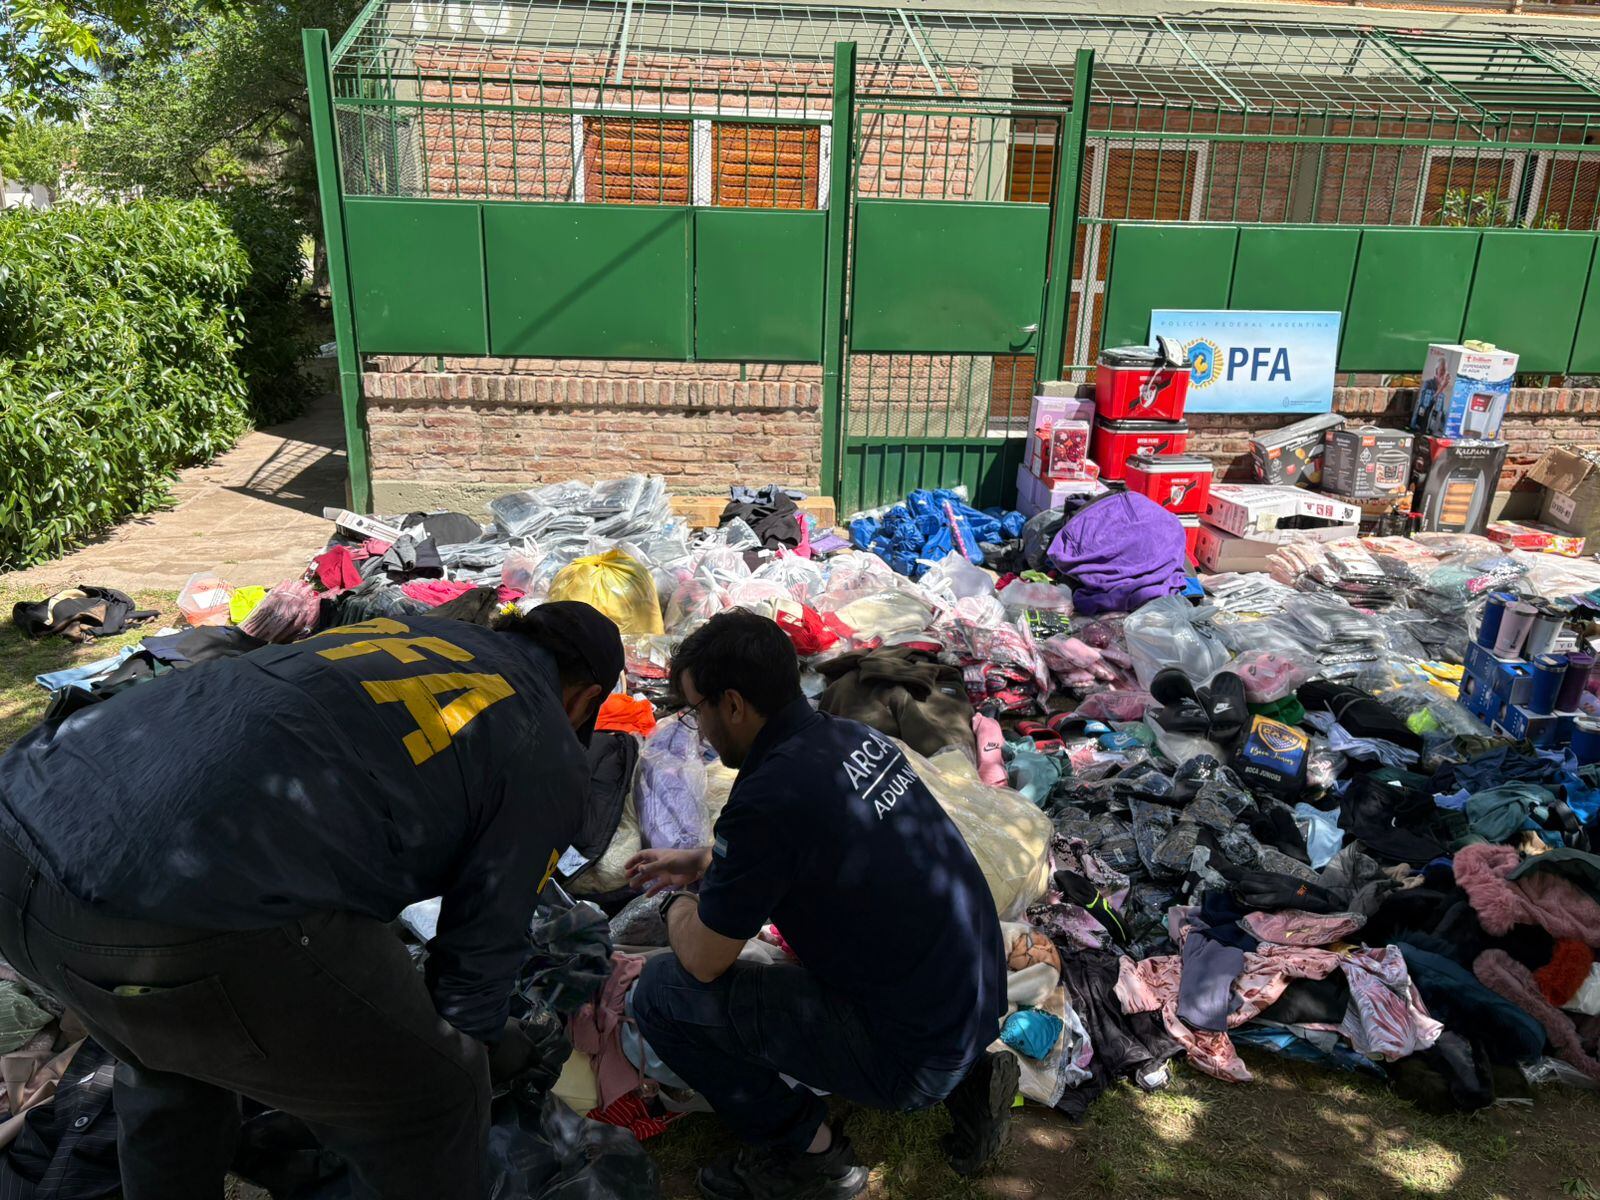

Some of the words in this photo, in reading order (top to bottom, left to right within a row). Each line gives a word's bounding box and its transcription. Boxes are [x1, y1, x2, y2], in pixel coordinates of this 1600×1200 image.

[1226, 347, 1291, 382] PFA
[1455, 447, 1490, 456] KALPANA
[842, 733, 893, 790] ARCA
[1245, 766, 1259, 774] BOCA
[1260, 769, 1281, 781] JUNIORS
[873, 762, 917, 820] ADUAN
